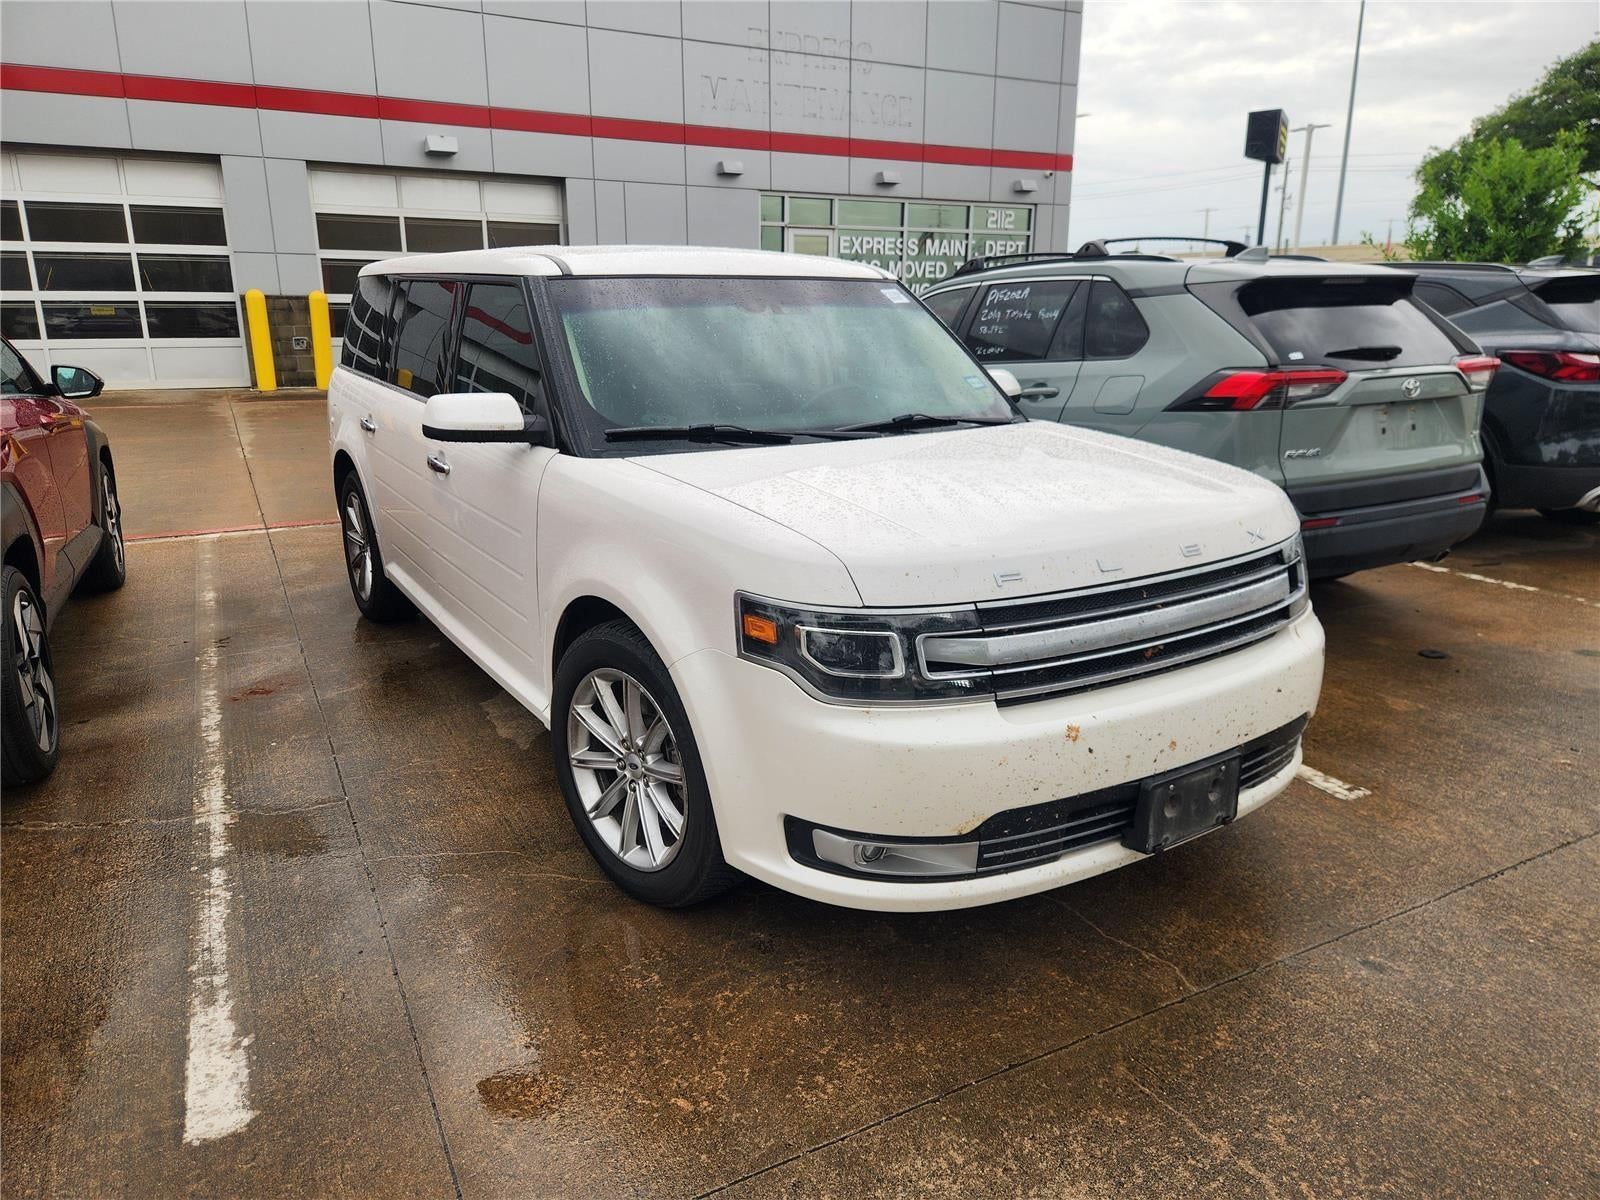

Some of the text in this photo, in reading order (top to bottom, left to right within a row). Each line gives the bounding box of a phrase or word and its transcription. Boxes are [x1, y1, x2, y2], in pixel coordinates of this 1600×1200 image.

[987, 209, 1016, 229] 2112
[839, 235, 919, 256] EXPRESS
[889, 260, 948, 279] MOVED
[992, 527, 1266, 588] FLEX
